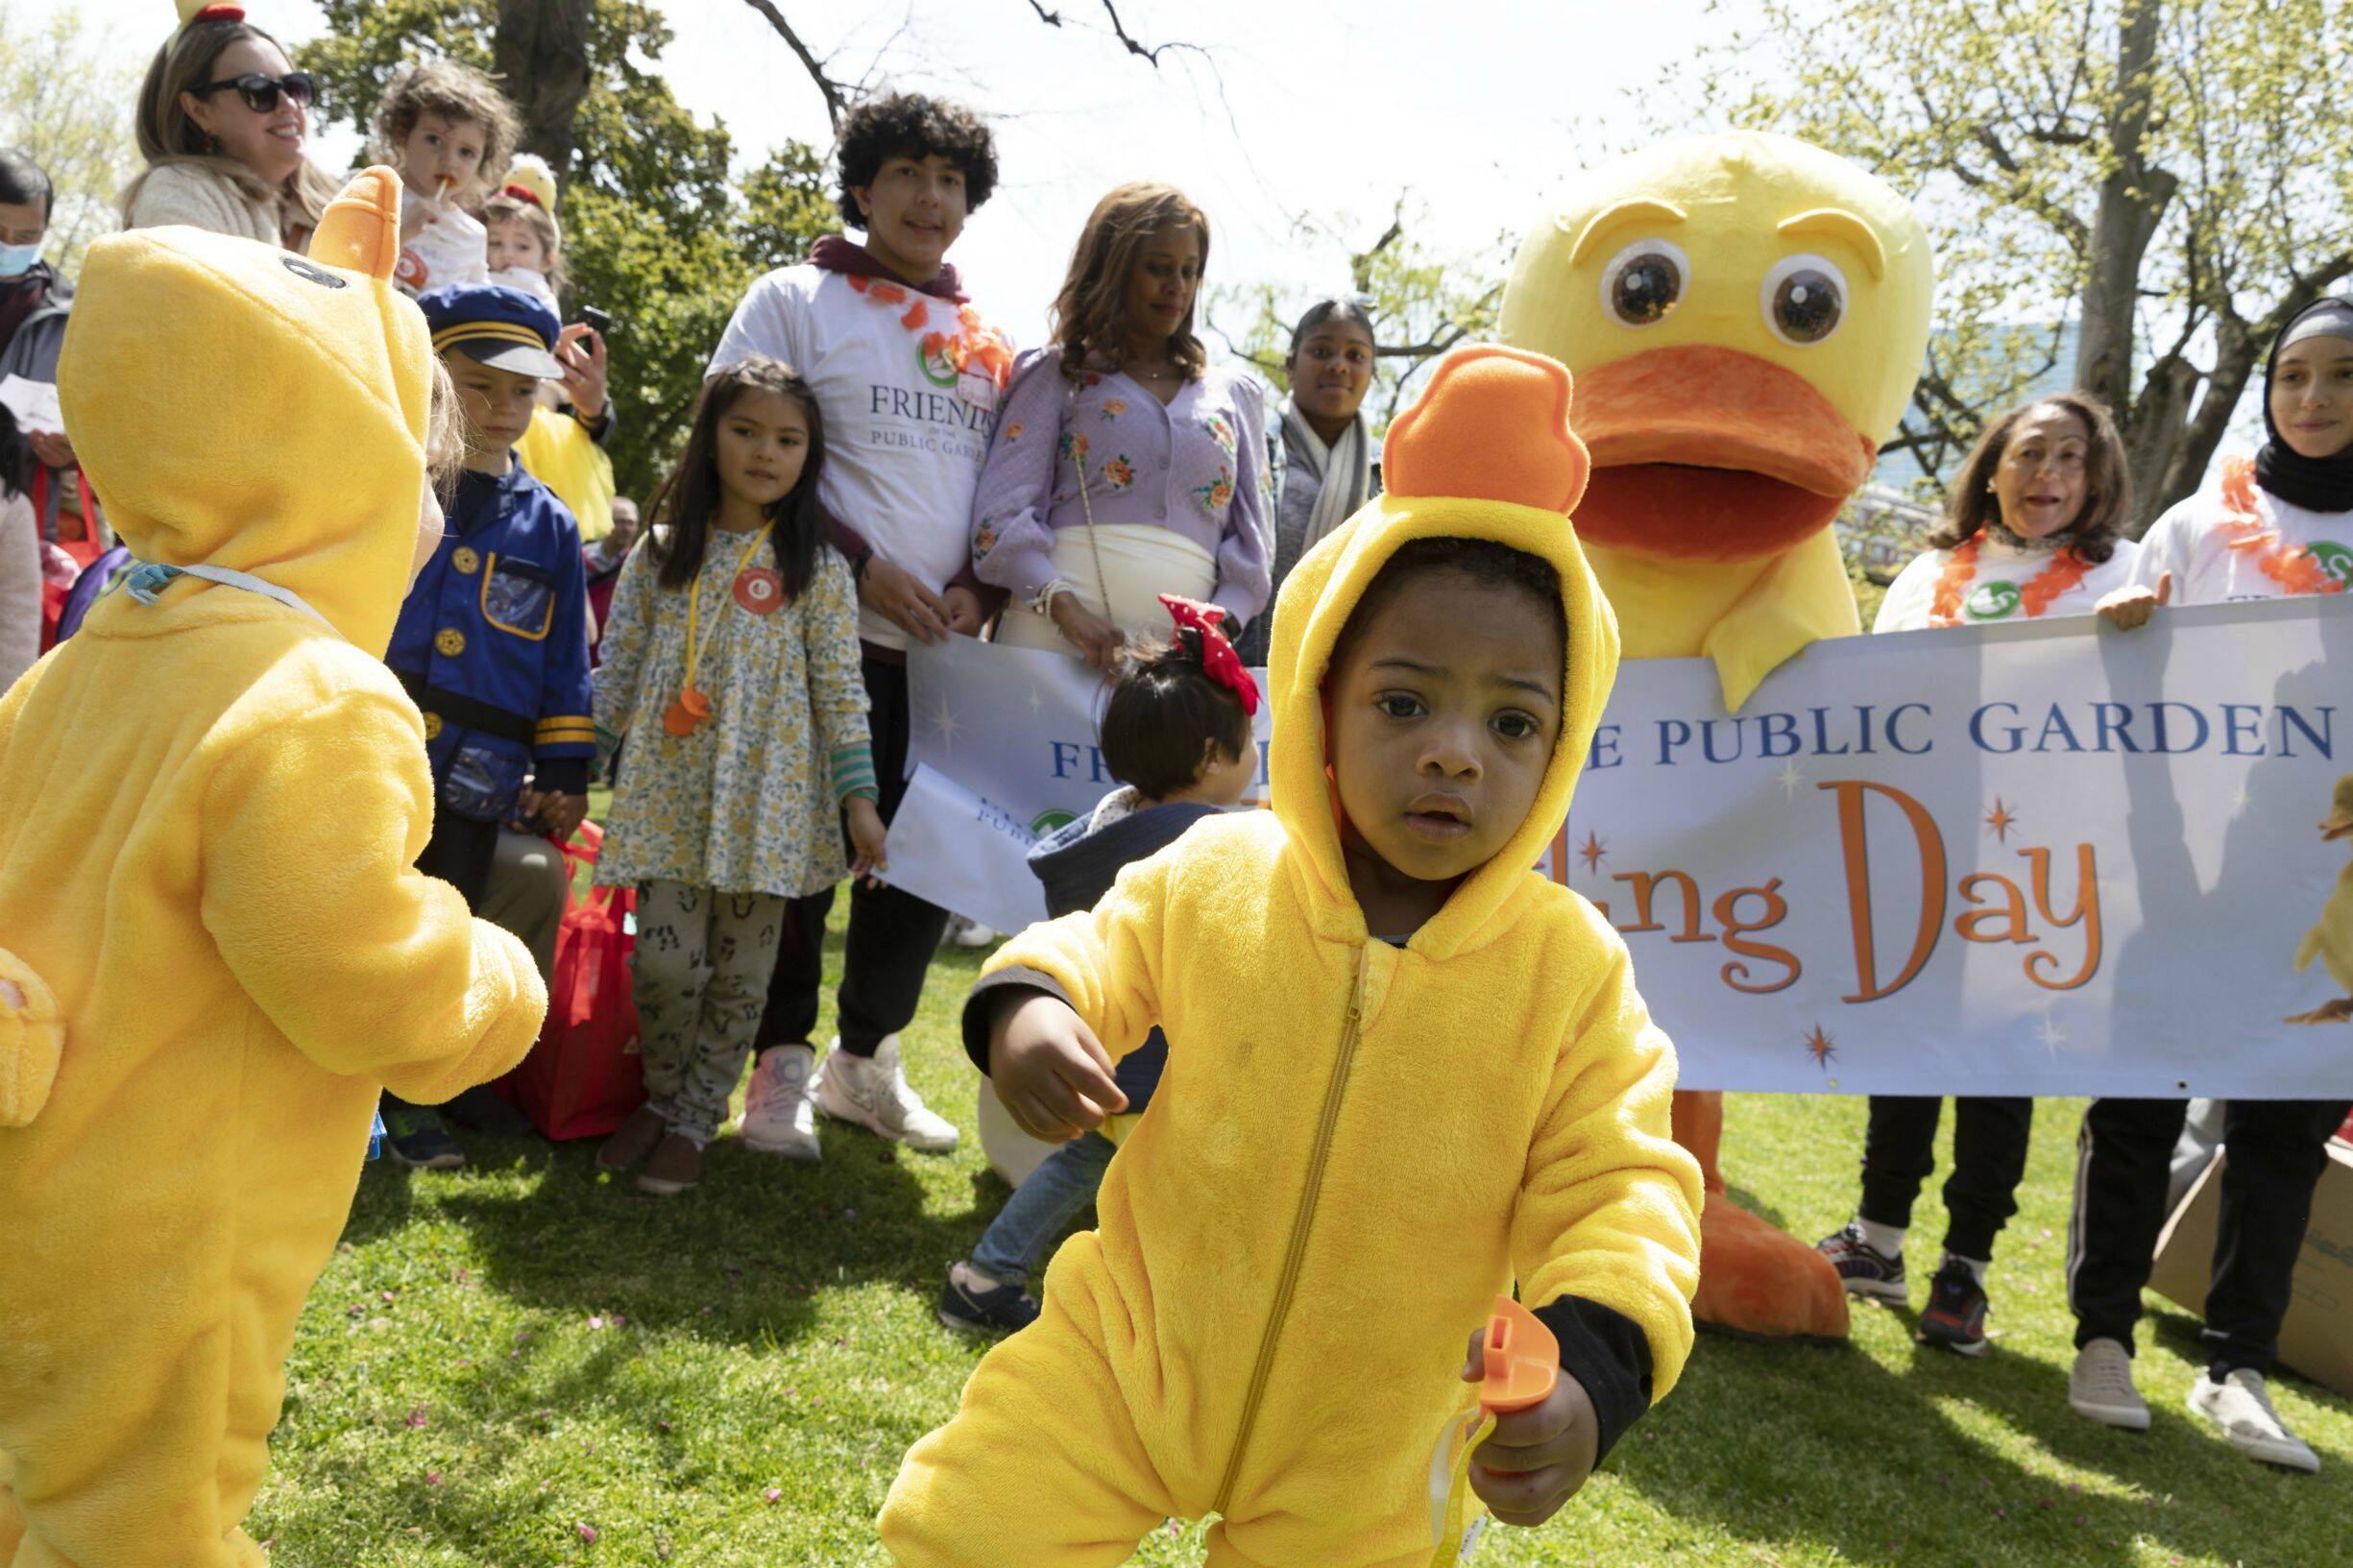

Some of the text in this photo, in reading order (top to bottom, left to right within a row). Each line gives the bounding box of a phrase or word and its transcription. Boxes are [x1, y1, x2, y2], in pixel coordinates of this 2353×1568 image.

[871, 430, 937, 452] PUBLIC
[1654, 703, 1934, 766] PUBLIC
[1968, 701, 2338, 760] GARDEN
[1816, 779, 2103, 1004] Day
